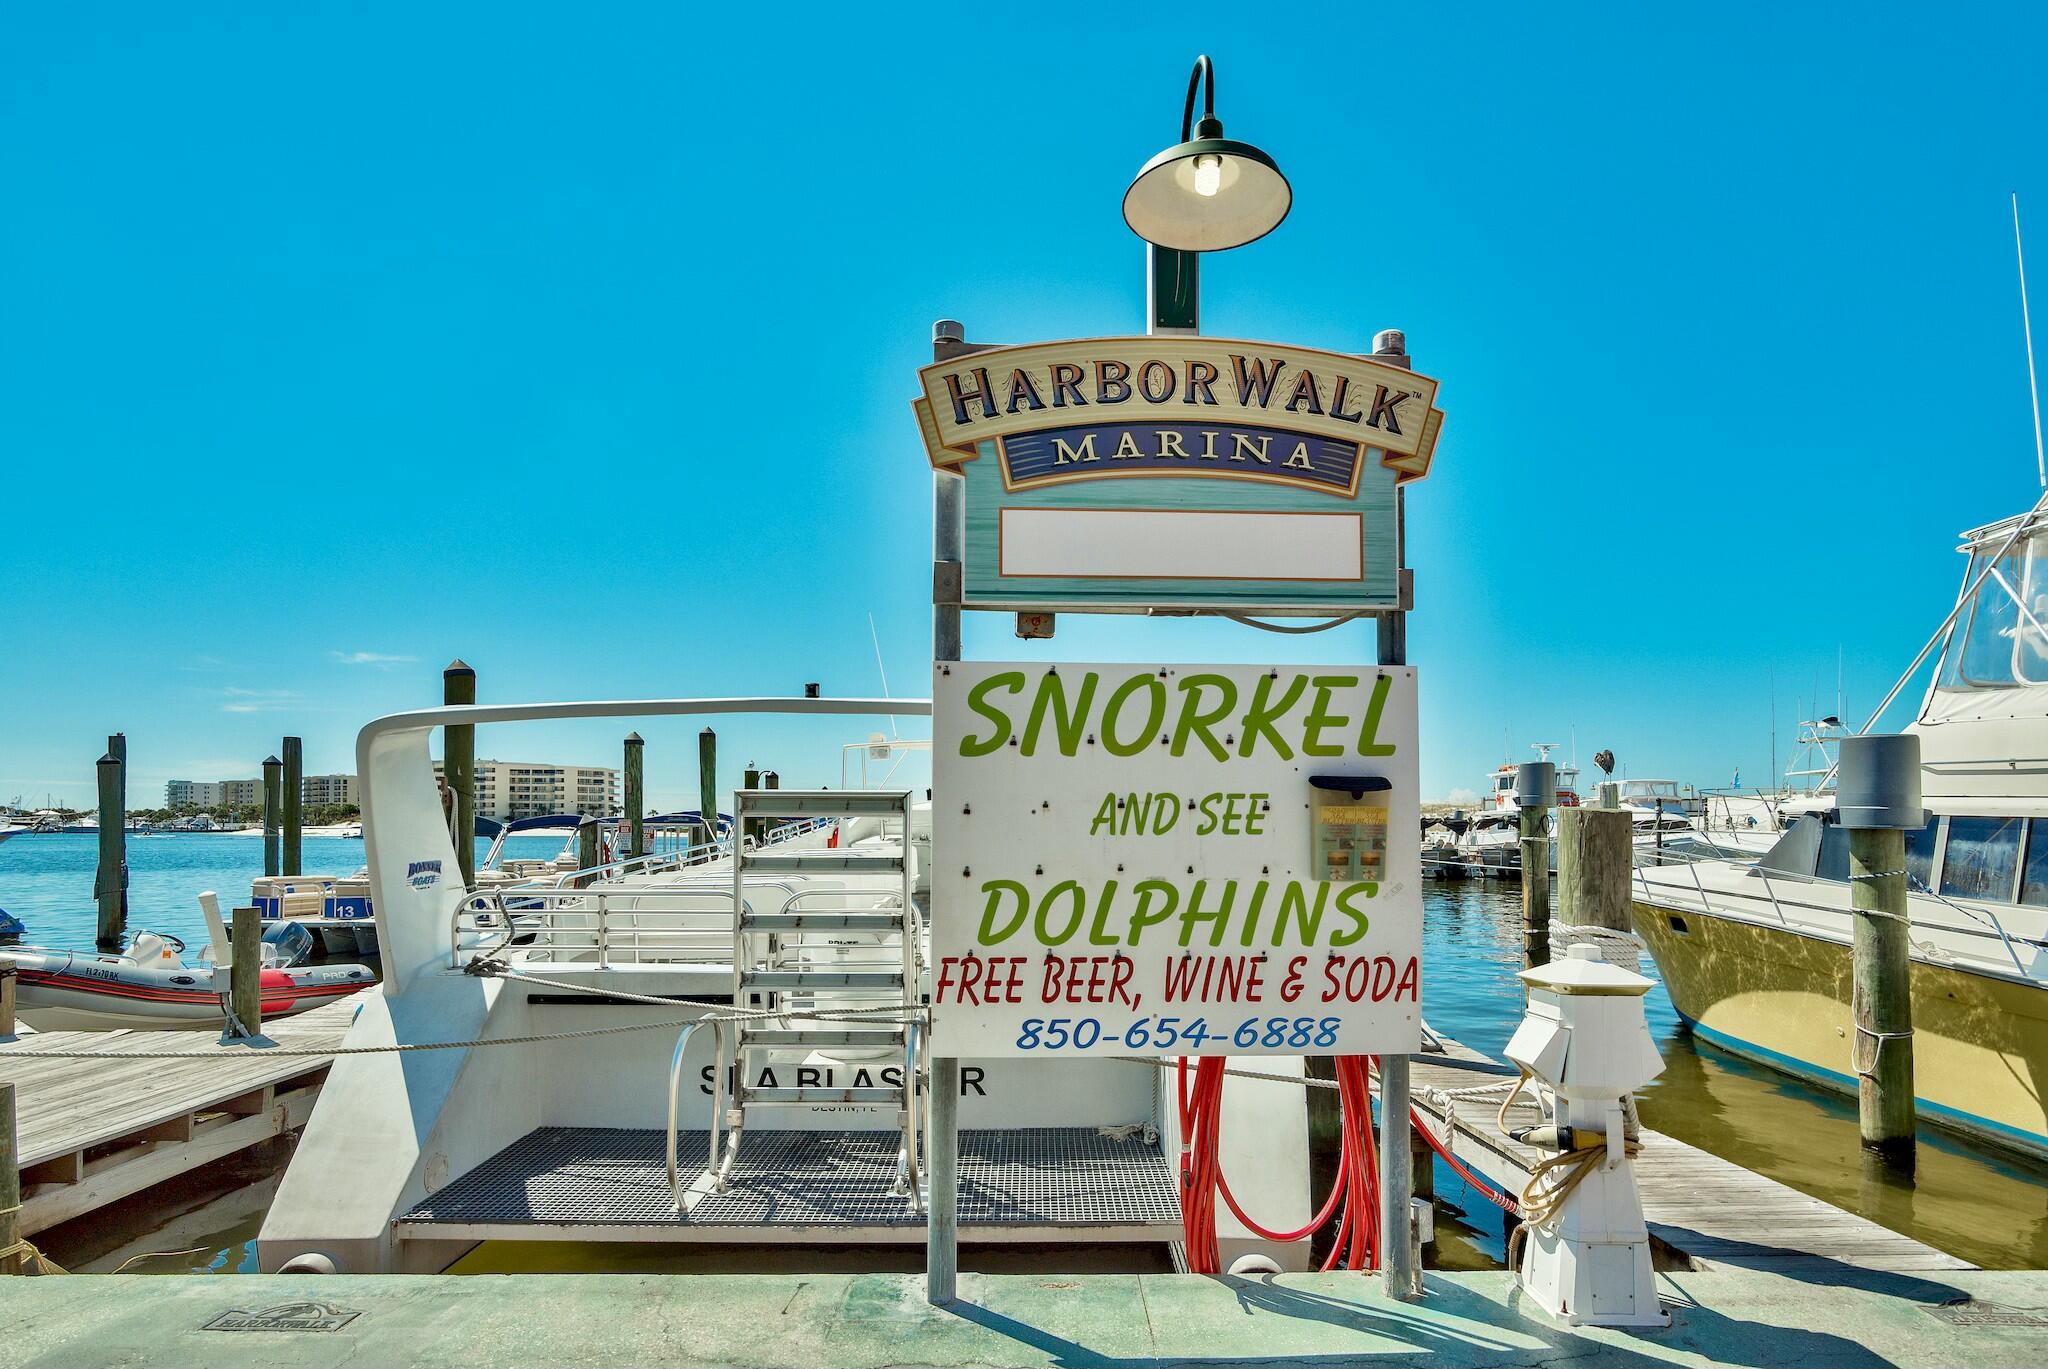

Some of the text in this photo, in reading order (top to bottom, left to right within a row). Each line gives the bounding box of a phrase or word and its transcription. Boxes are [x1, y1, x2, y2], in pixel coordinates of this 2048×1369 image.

[942, 354, 1411, 436] HARBORWALK
[1051, 430, 1315, 471] MARINA
[959, 671, 1397, 763] SNORKEL
[1089, 792, 1269, 836] AND SEE
[337, 906, 354, 918] 13
[976, 879, 1379, 947] DOLPHINS
[936, 955, 1418, 1011] FREE BEER, WINE & SODA
[1015, 1017, 1341, 1050] 850-654-6888
